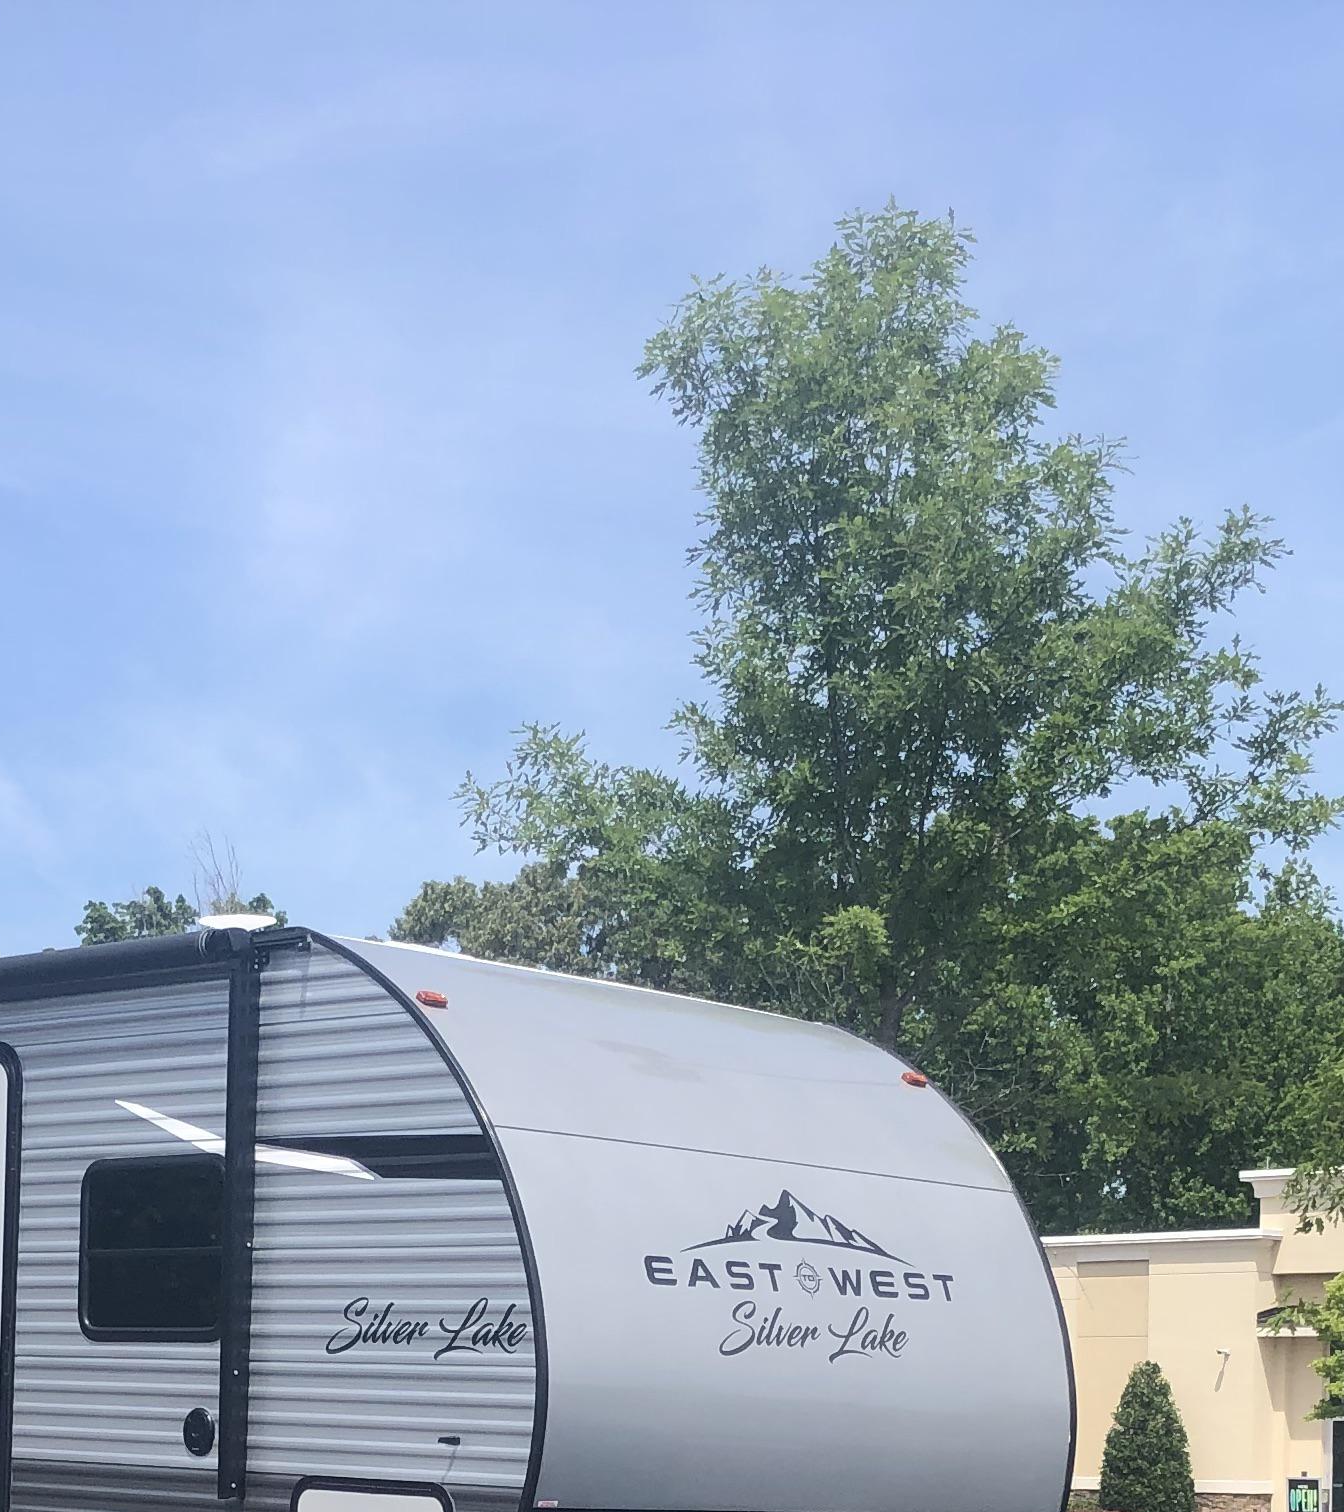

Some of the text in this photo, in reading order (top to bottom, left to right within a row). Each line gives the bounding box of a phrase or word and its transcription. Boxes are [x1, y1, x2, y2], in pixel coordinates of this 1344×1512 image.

[643, 1254, 955, 1302] EAST TO WEST
[325, 1296, 528, 1361] Silver Lake
[719, 1300, 910, 1364] Silver Lake
